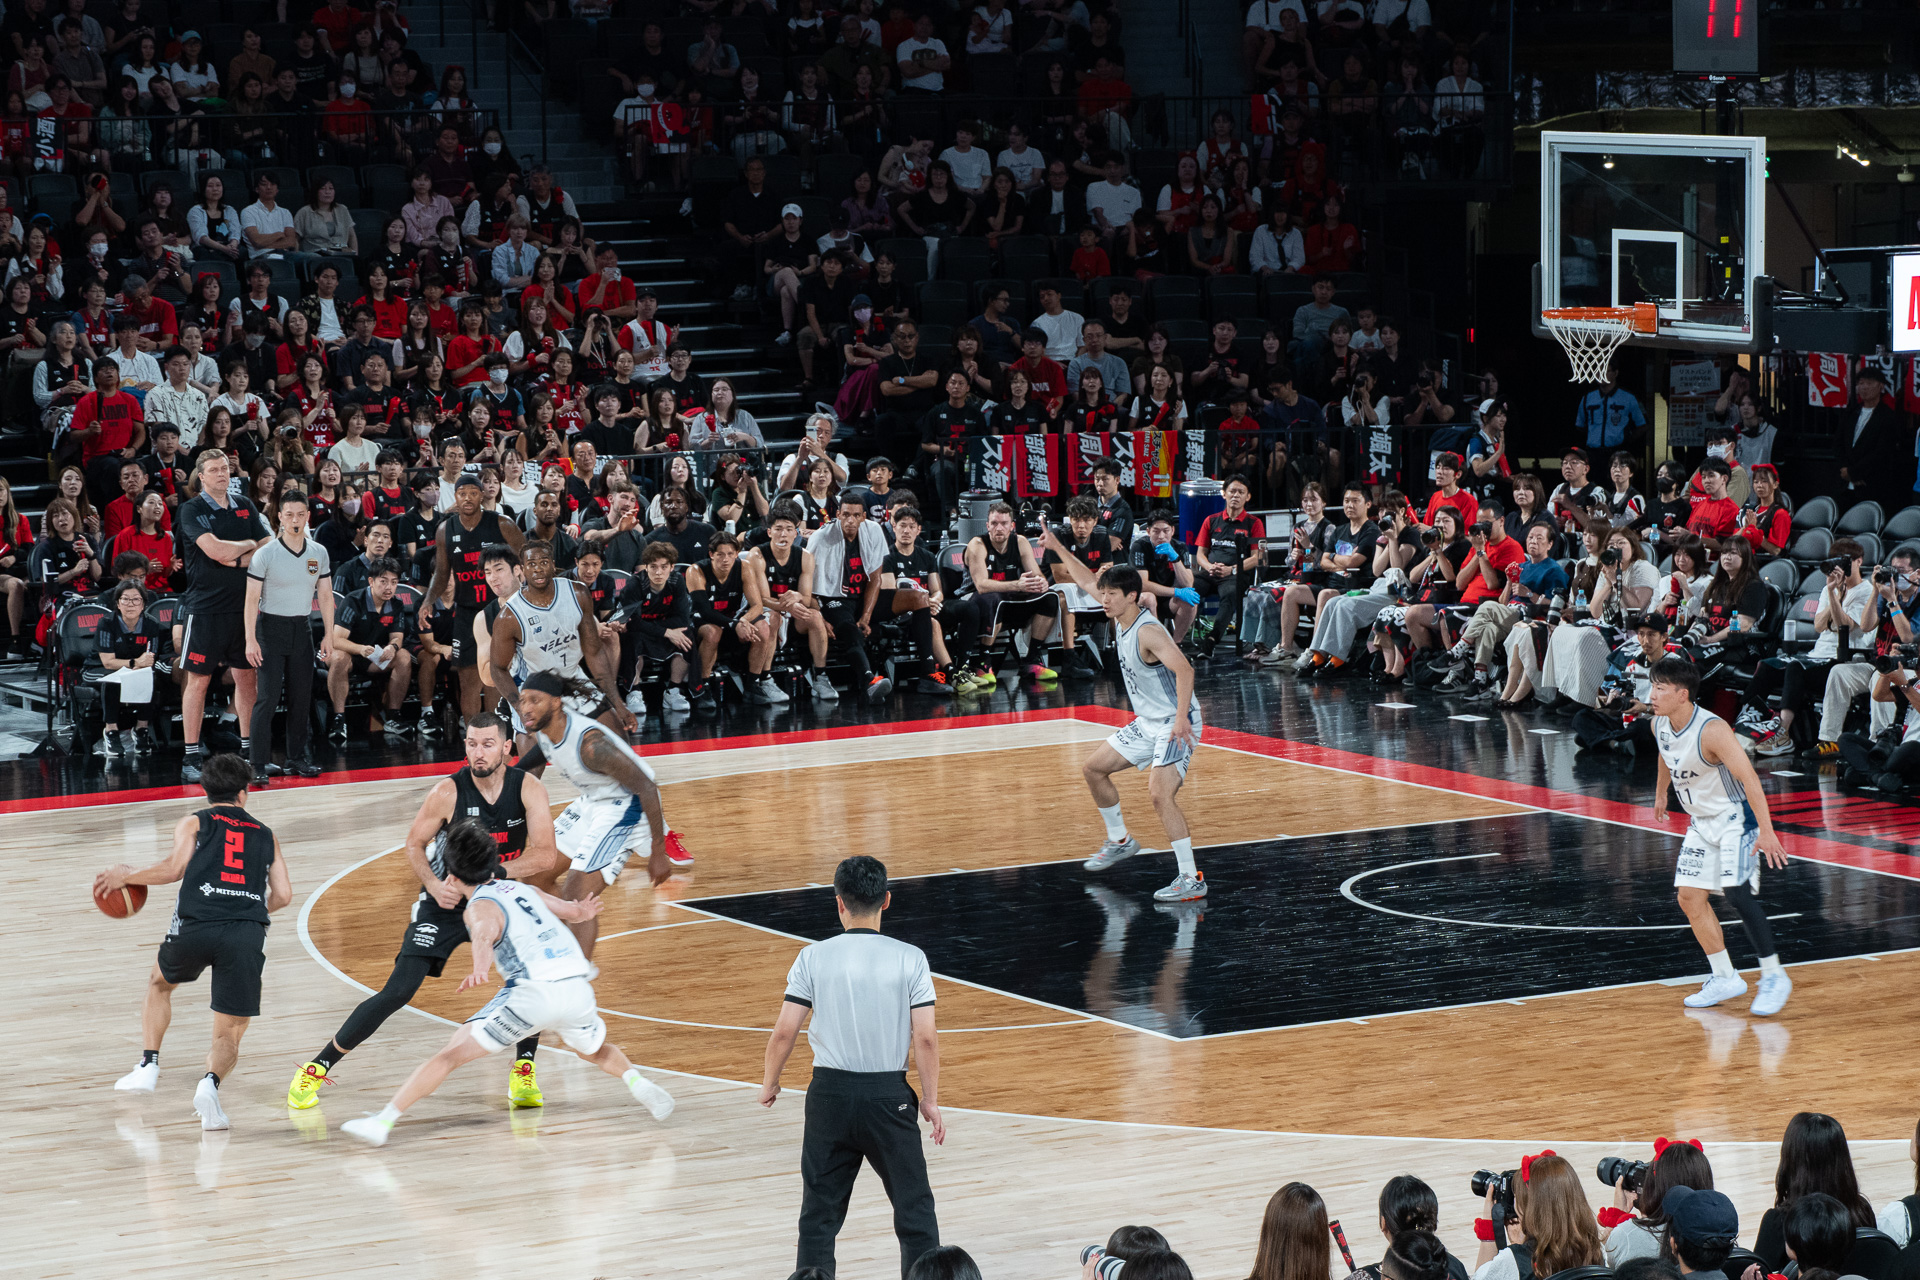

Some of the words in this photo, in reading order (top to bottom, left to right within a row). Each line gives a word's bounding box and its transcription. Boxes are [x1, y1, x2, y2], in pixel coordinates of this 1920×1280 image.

[314, 435, 327, 444] 75
[456, 569, 486, 583] TOYO
[473, 584, 487, 603] 17
[540, 634, 578, 653] VELCA
[560, 653, 567, 668] 7
[224, 828, 245, 869] 2
[414, 933, 435, 942] TOYOTA
